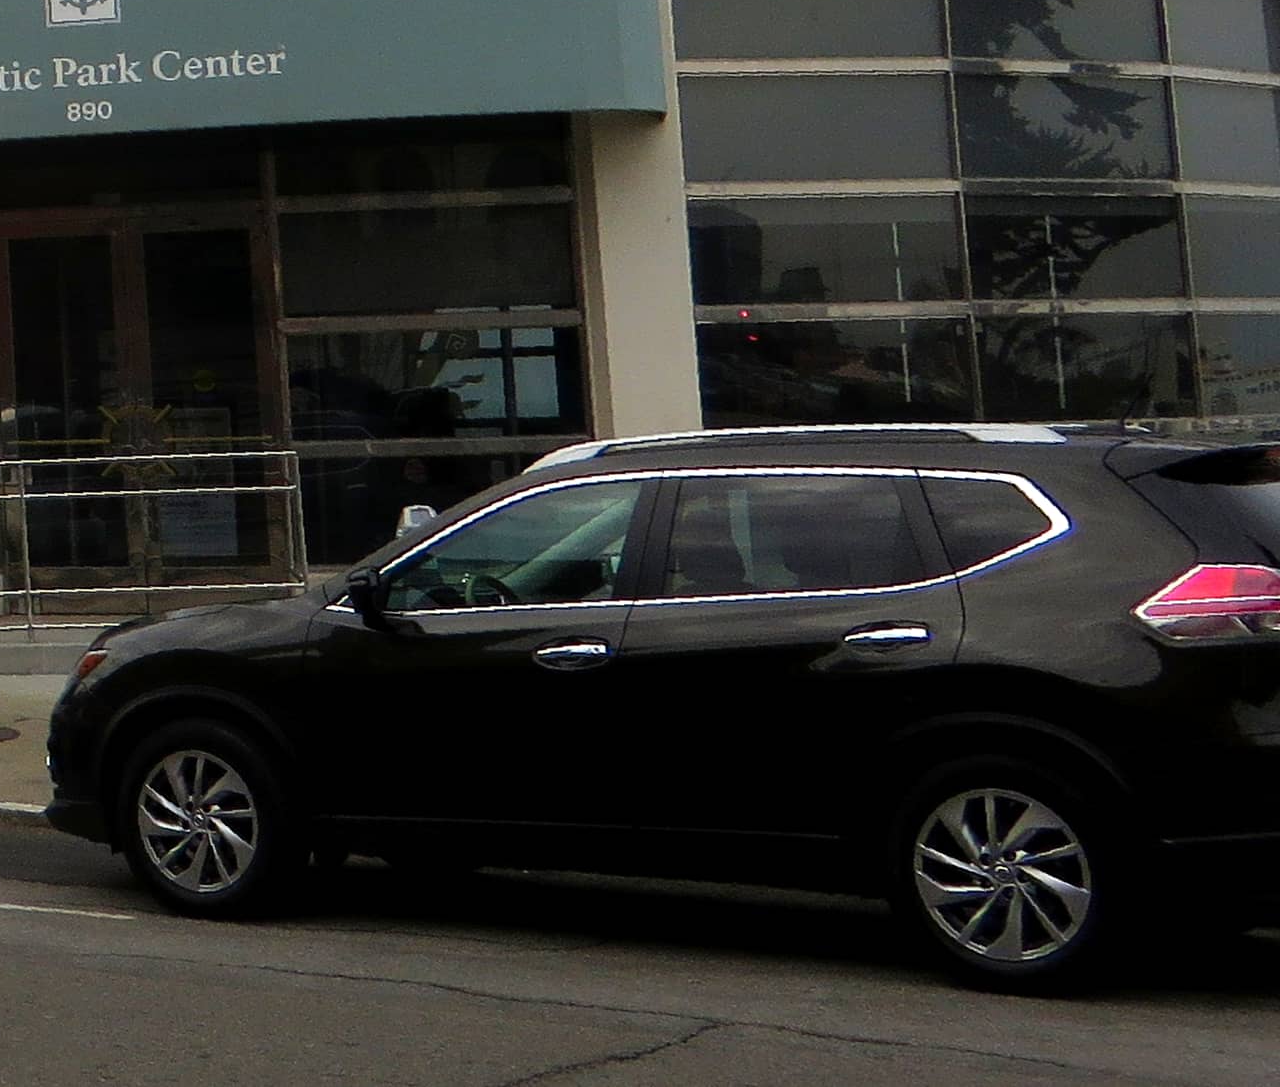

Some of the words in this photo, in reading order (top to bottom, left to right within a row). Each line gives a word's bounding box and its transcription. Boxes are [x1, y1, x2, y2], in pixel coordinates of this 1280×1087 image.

[52, 52, 142, 88] Park
[152, 48, 287, 83] Center
[66, 101, 113, 122] 890
